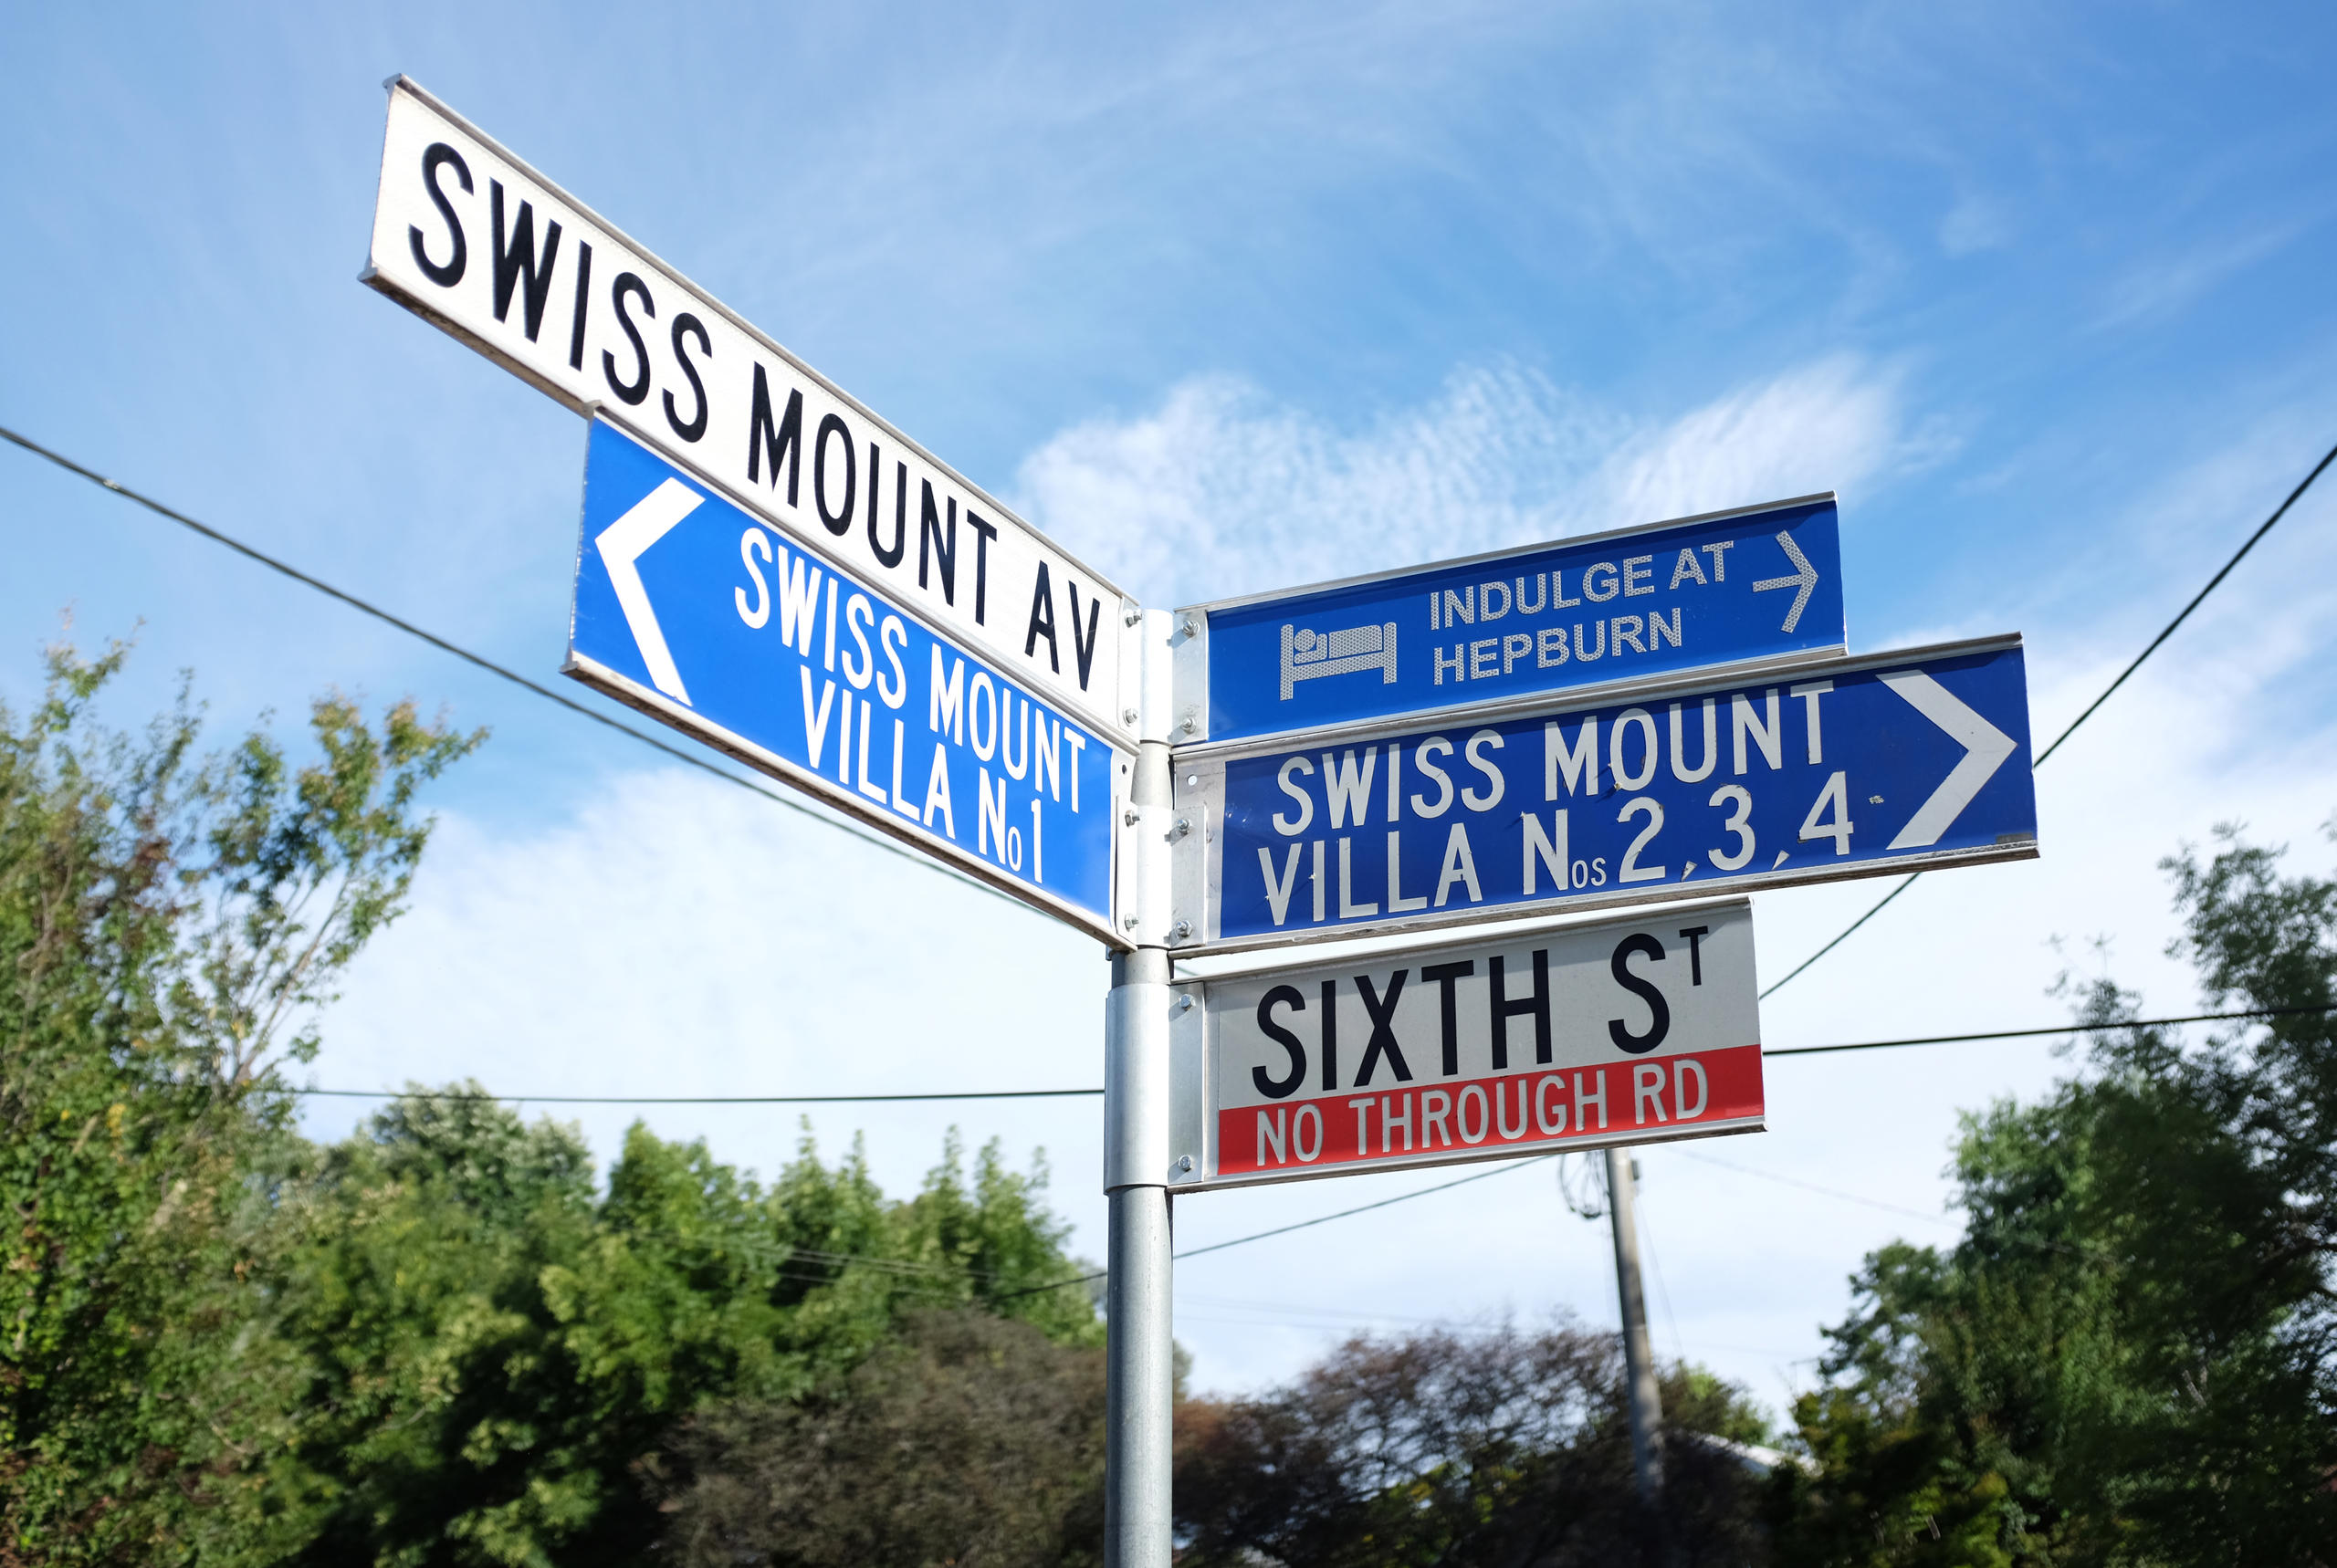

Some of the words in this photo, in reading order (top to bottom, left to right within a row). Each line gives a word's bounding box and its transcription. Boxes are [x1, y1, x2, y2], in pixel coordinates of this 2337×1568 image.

[408, 142, 713, 443] SWISS
[748, 361, 998, 627] MOUNT
[1024, 560, 1101, 692] AV
[1430, 555, 1653, 630] INDULGE
[1669, 540, 1734, 590] AT
[1434, 608, 1682, 685] HEPBURN
[735, 528, 908, 709] SWISS
[929, 643, 1086, 813] MOUNT
[800, 664, 955, 840] VILLA
[1273, 734, 1505, 837] SWISS
[1545, 683, 1834, 802] MOUNT
[1257, 823, 1483, 926] VILLA
[1252, 949, 1552, 1099] SIXTH
[1256, 1103, 1324, 1166] NO
[1348, 1070, 1608, 1155] THROUGH
[1634, 1059, 1708, 1124] RD
